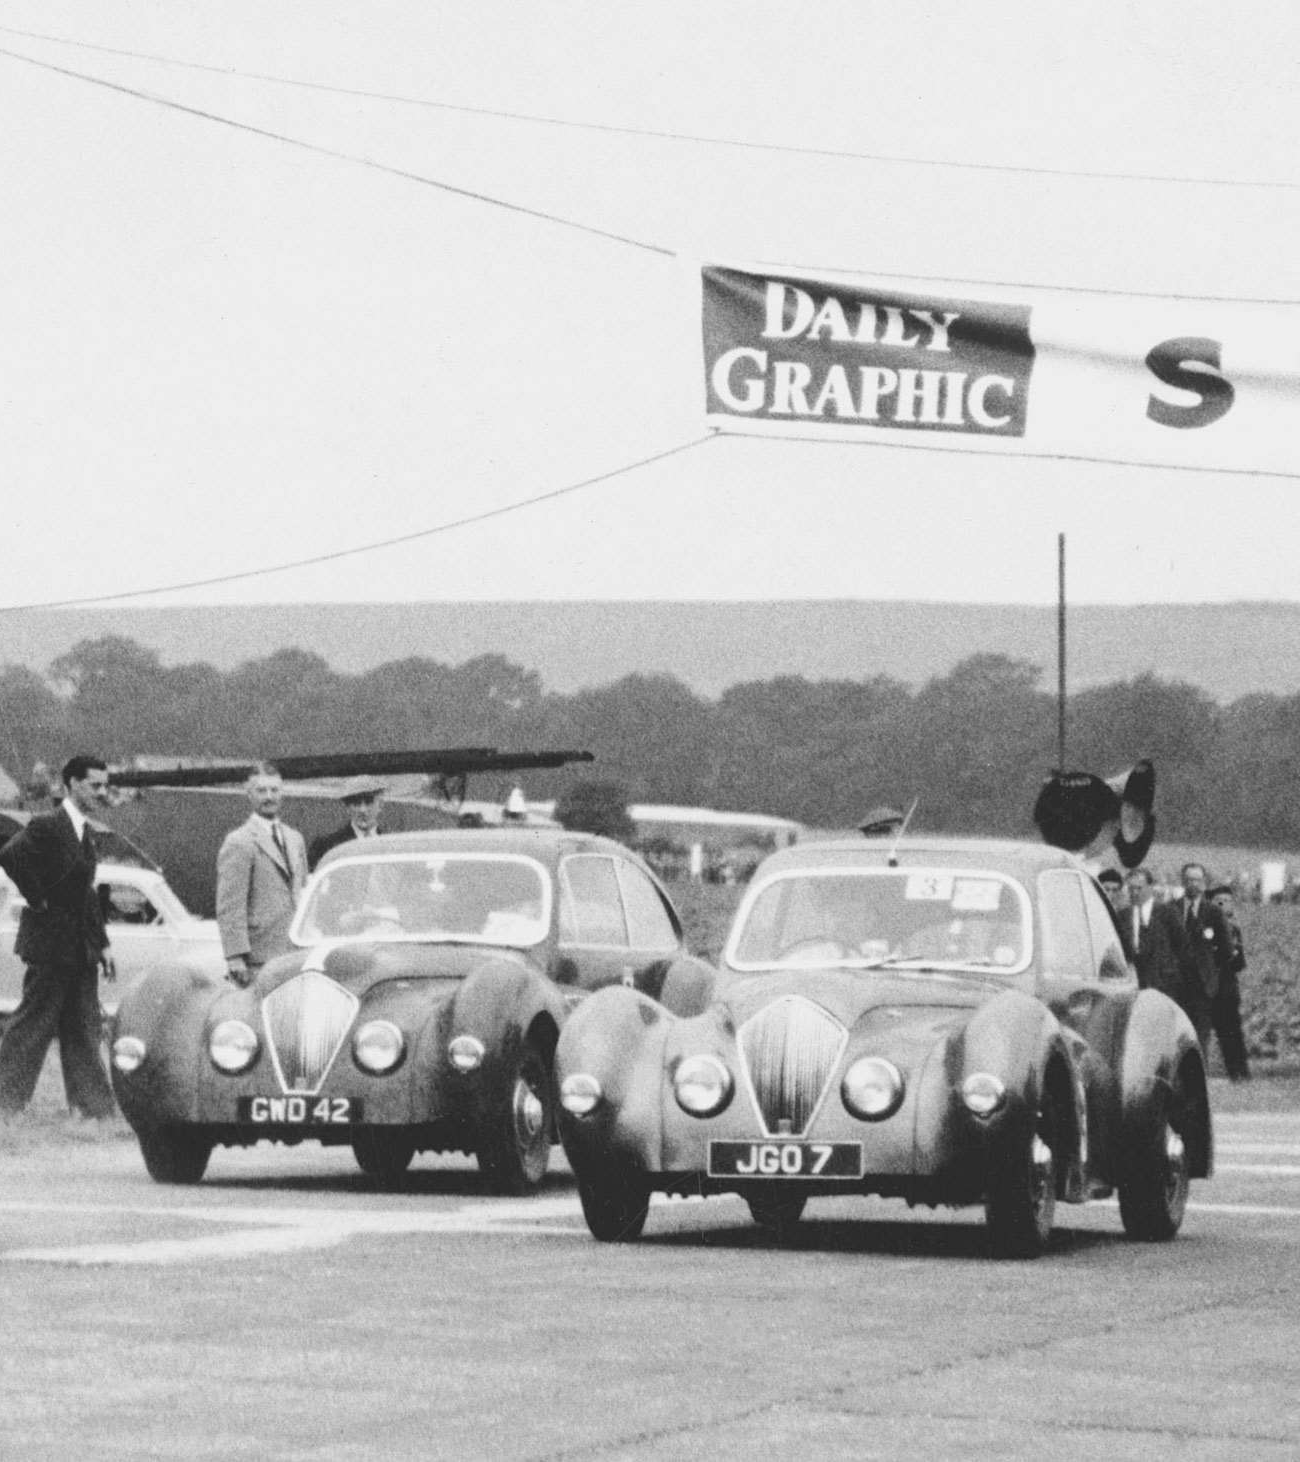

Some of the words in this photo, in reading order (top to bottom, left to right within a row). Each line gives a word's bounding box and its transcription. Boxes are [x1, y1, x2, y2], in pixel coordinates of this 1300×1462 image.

[761, 281, 960, 351] DAILY
[712, 346, 1014, 427] GRAPHIC
[251, 1097, 306, 1122] GWD
[313, 1097, 350, 1122] 42
[736, 1144, 802, 1174] JGO
[811, 1145, 833, 1174] 7
